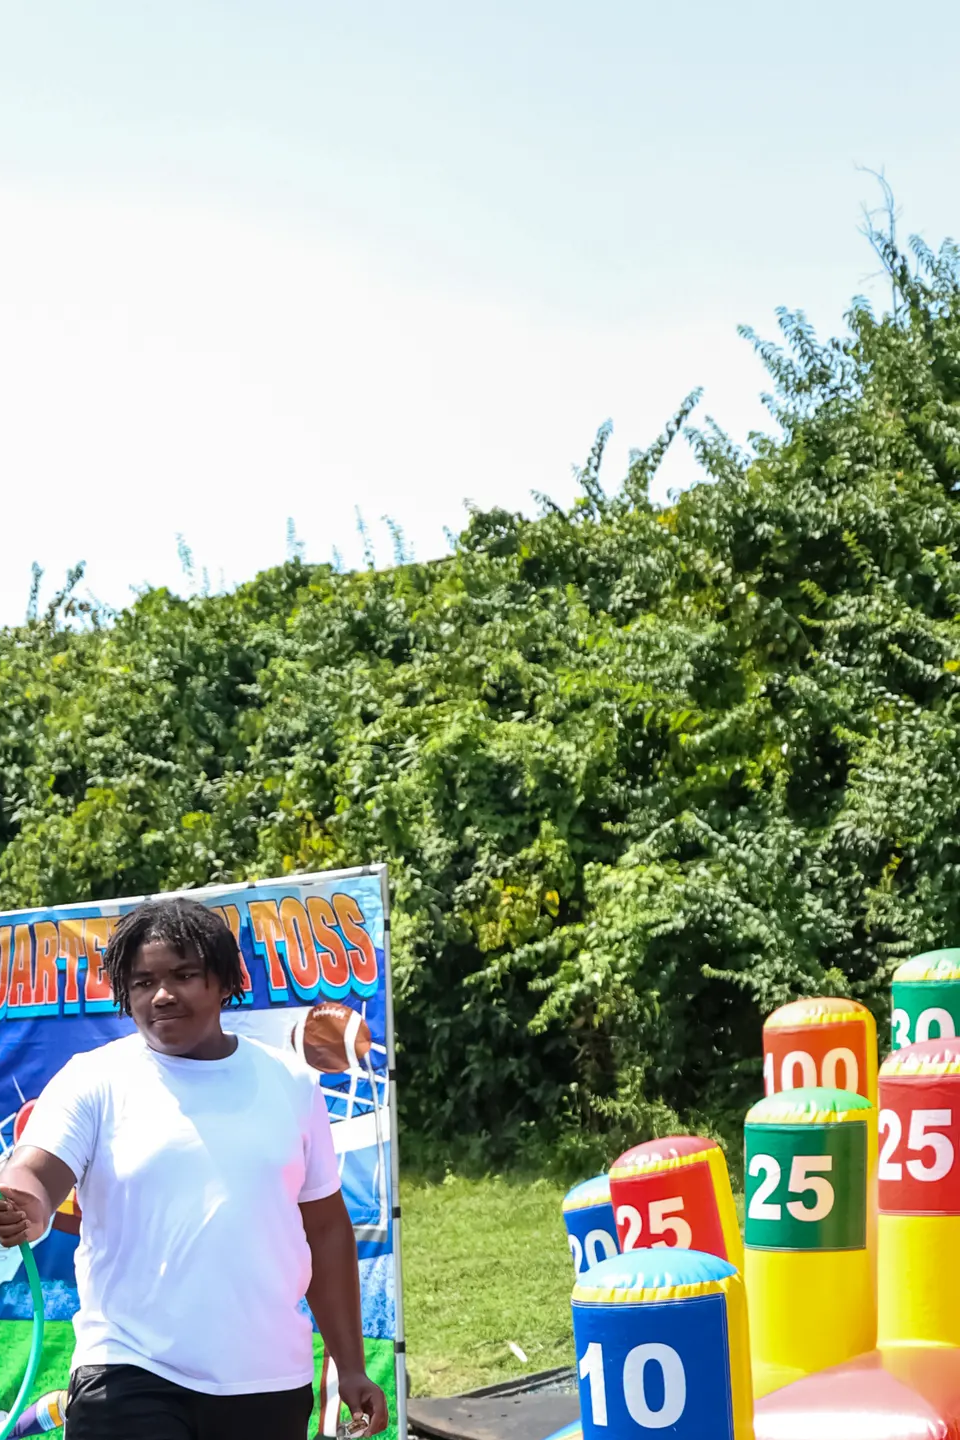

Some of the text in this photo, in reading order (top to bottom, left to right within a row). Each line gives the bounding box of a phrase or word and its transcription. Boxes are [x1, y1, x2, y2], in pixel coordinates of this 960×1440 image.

[249, 896, 380, 996] TOSS
[764, 1047, 859, 1100] 100
[878, 1109, 954, 1182] 25
[748, 1154, 835, 1222] 25
[568, 1229, 618, 1277] 20
[616, 1196, 693, 1252] 25
[579, 1342, 687, 1429] 10
